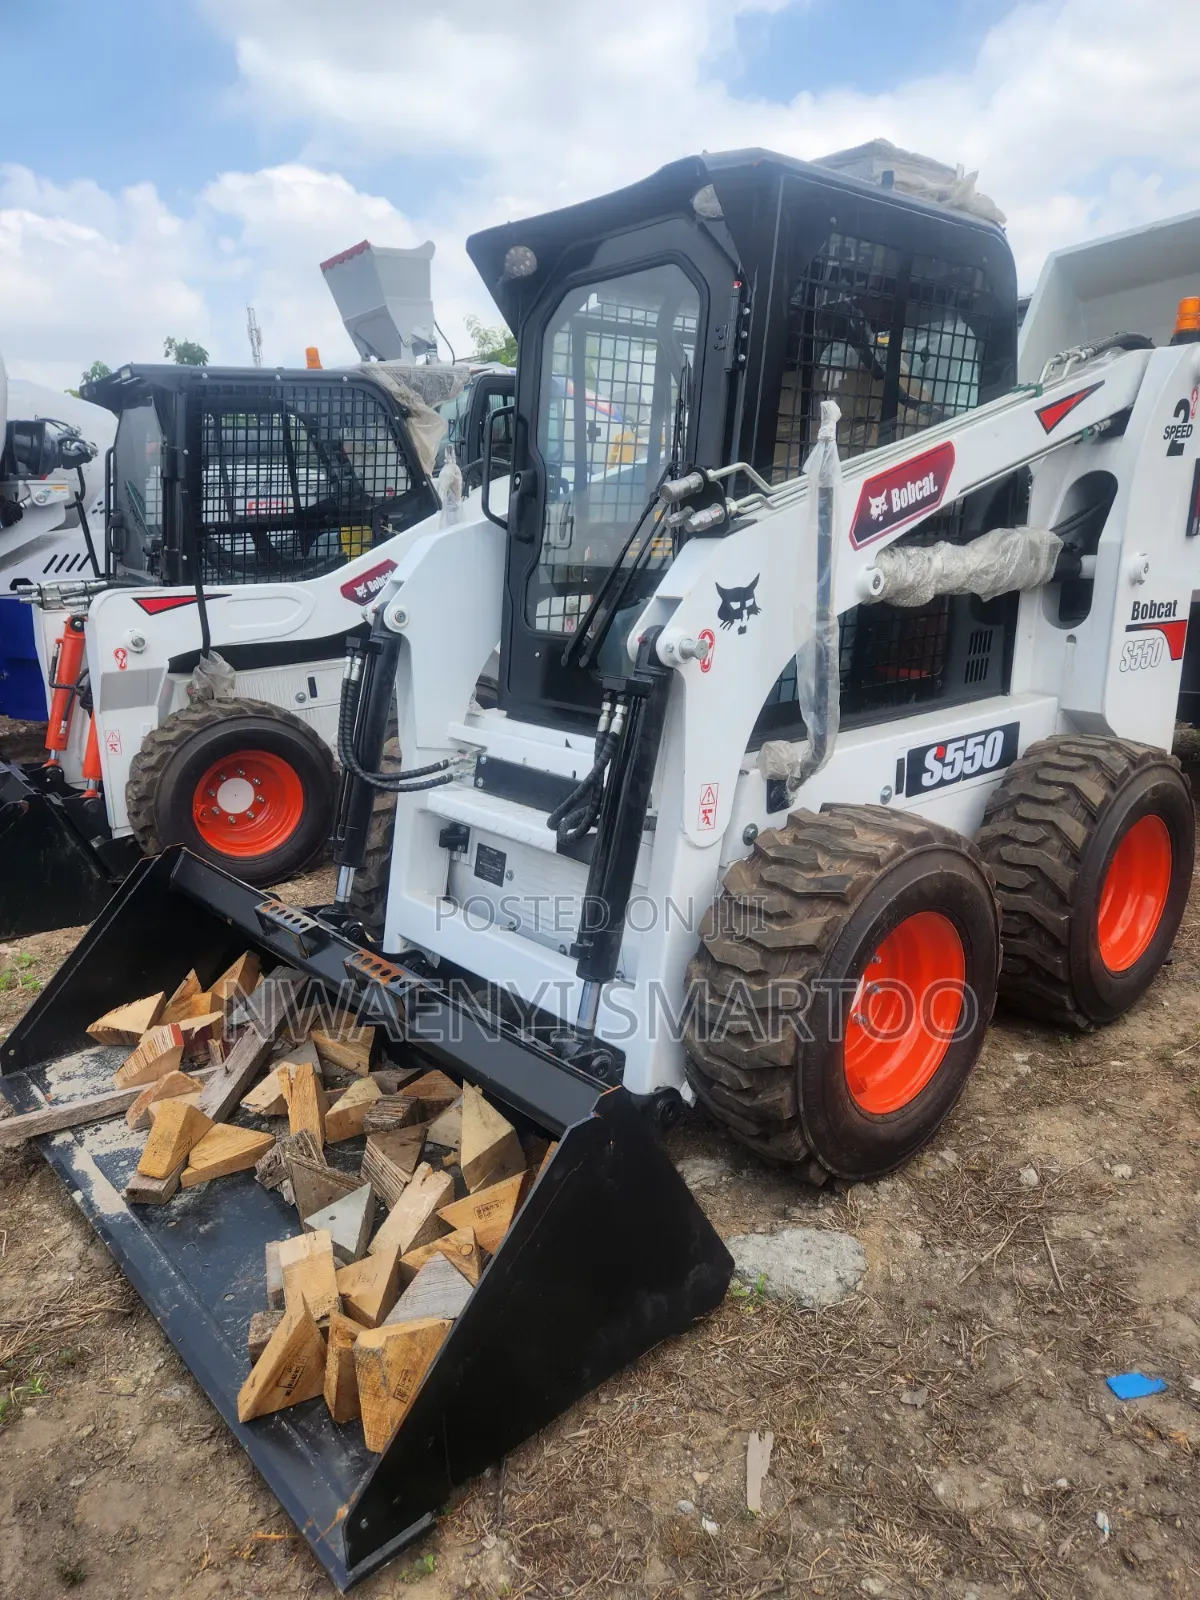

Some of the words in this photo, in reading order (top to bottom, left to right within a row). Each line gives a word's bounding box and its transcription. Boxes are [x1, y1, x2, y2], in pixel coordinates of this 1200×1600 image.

[1163, 423, 1193, 440] SPEED
[1166, 398, 1190, 456] 2
[1131, 600, 1178, 620] Bobcat
[1119, 636, 1164, 672] S550
[921, 730, 1004, 787] S550
